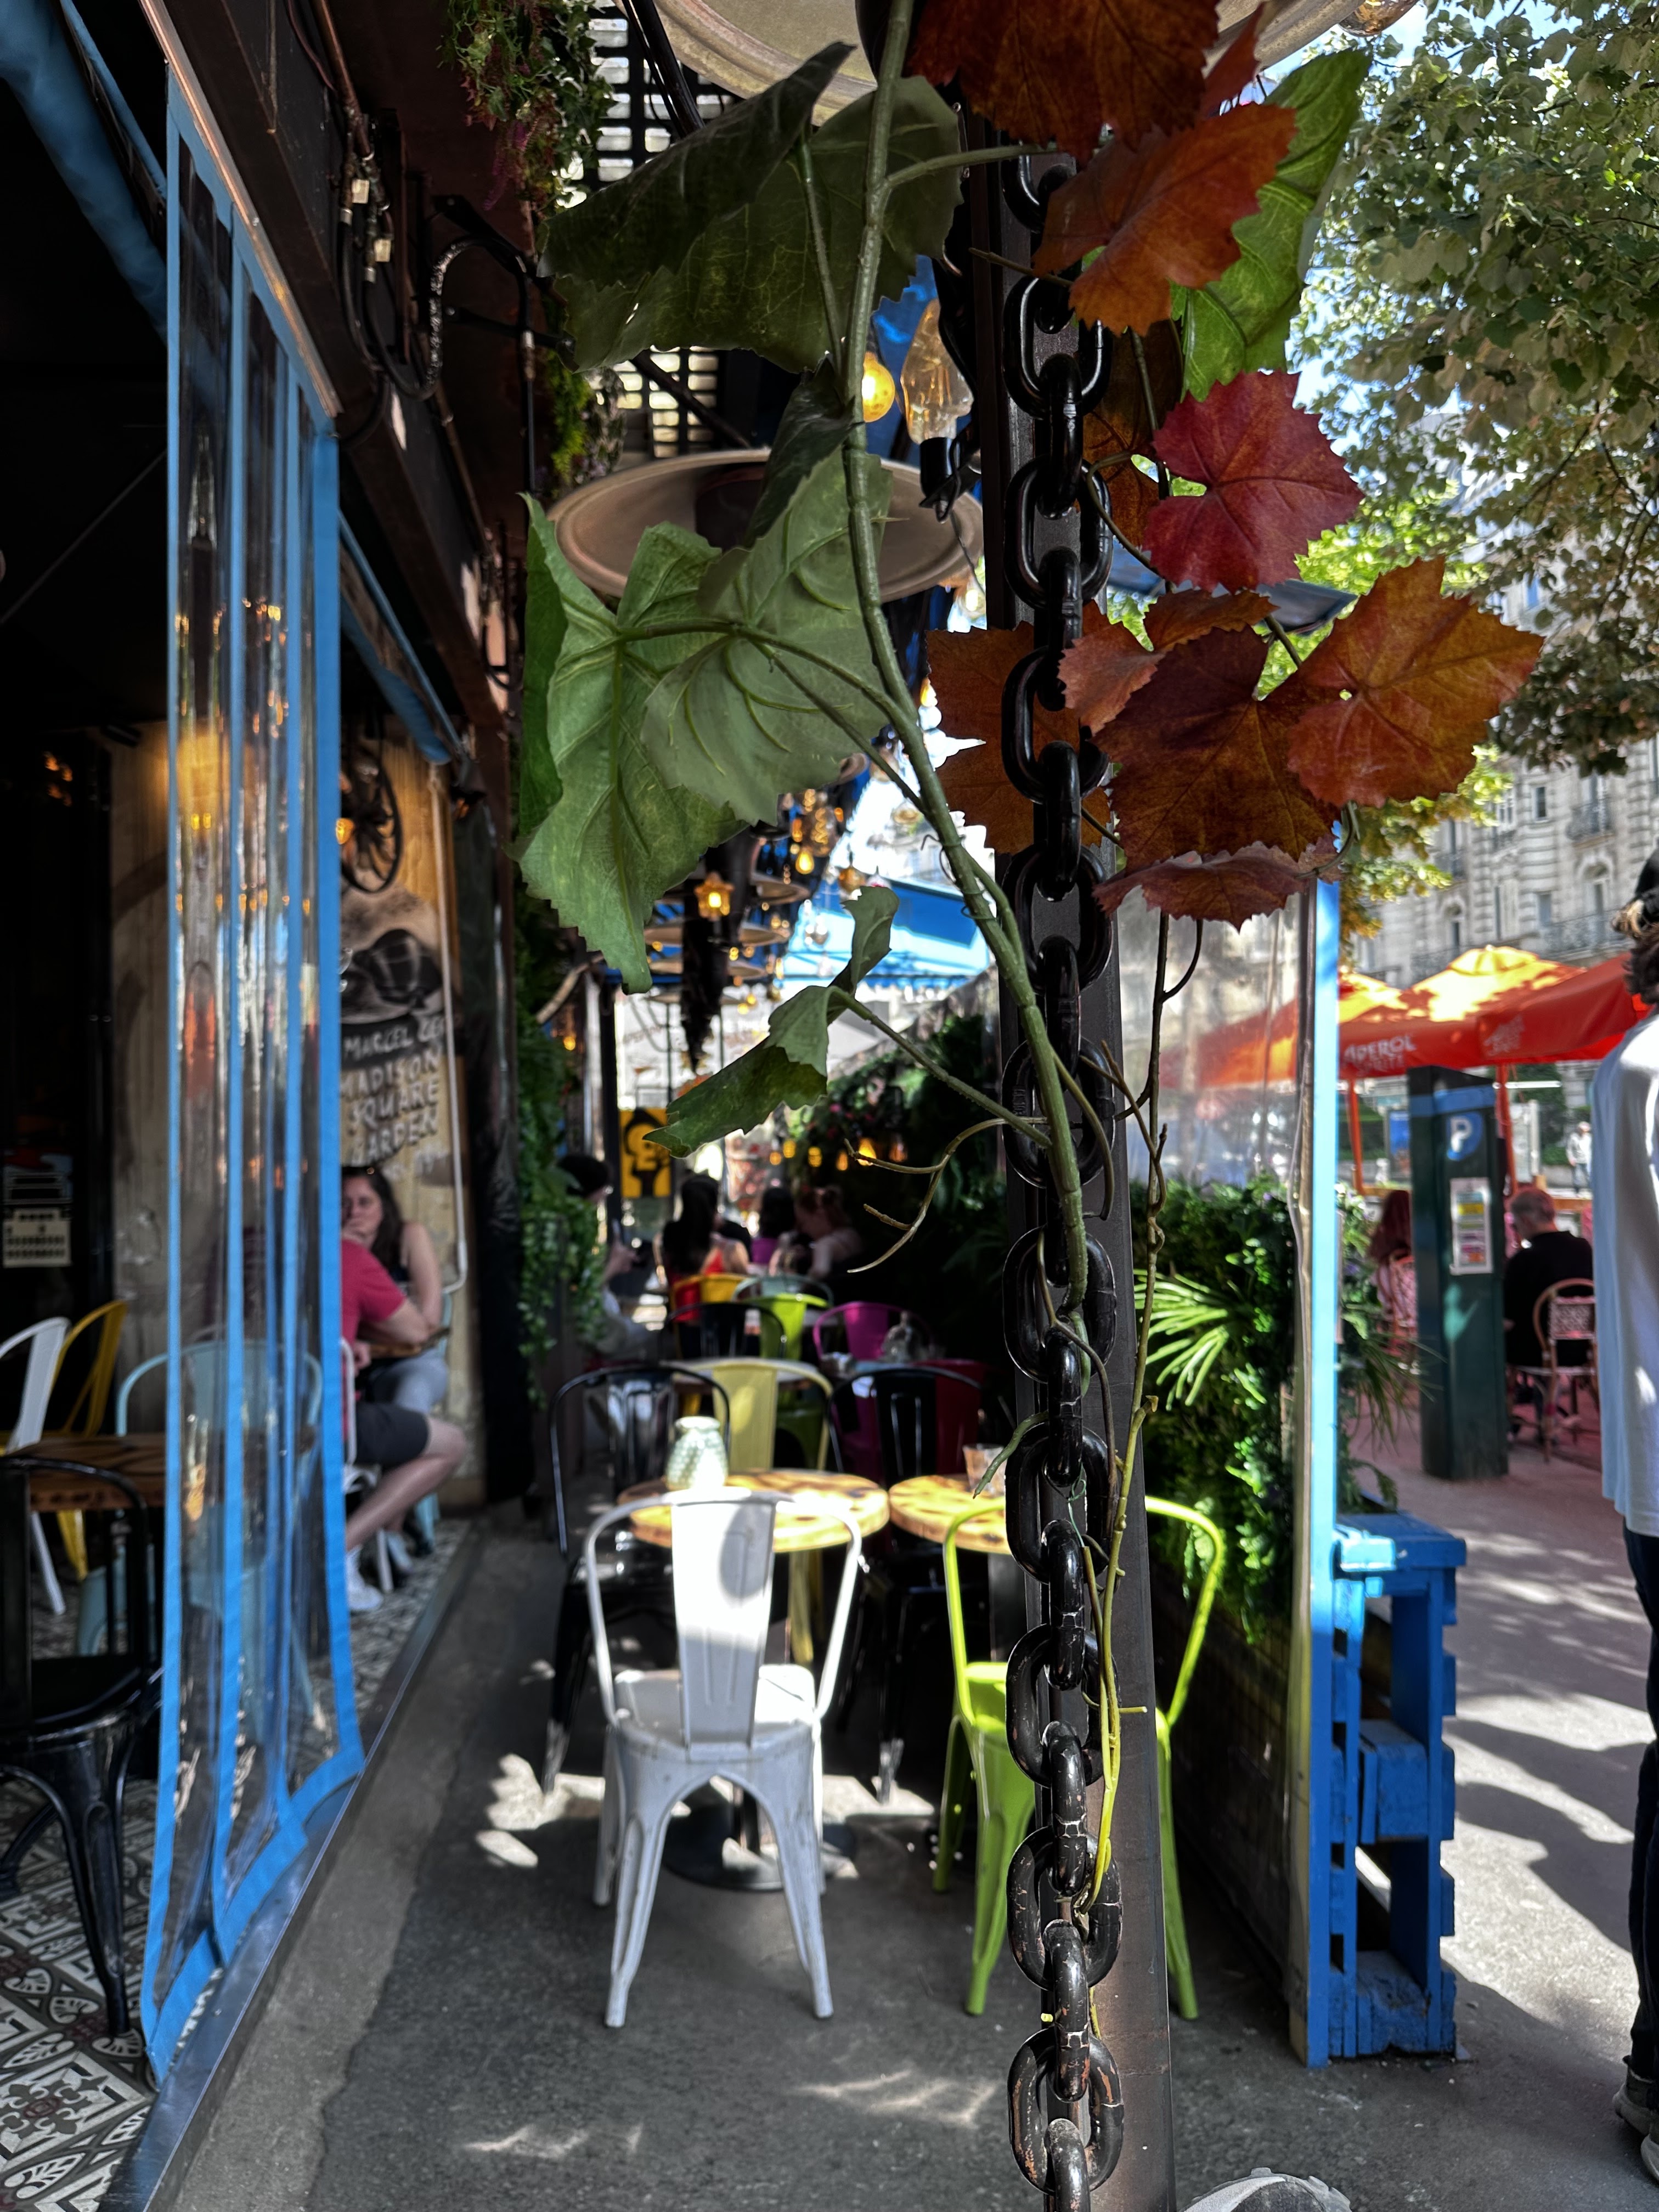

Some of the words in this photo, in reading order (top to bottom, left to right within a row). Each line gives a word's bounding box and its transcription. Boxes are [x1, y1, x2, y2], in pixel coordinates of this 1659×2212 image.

[1344, 1035, 1417, 1063] APEROL
[341, 1045, 442, 1098] MADISON
[352, 1080, 439, 1129] SQUARE
[1450, 1115, 1472, 1152] P
